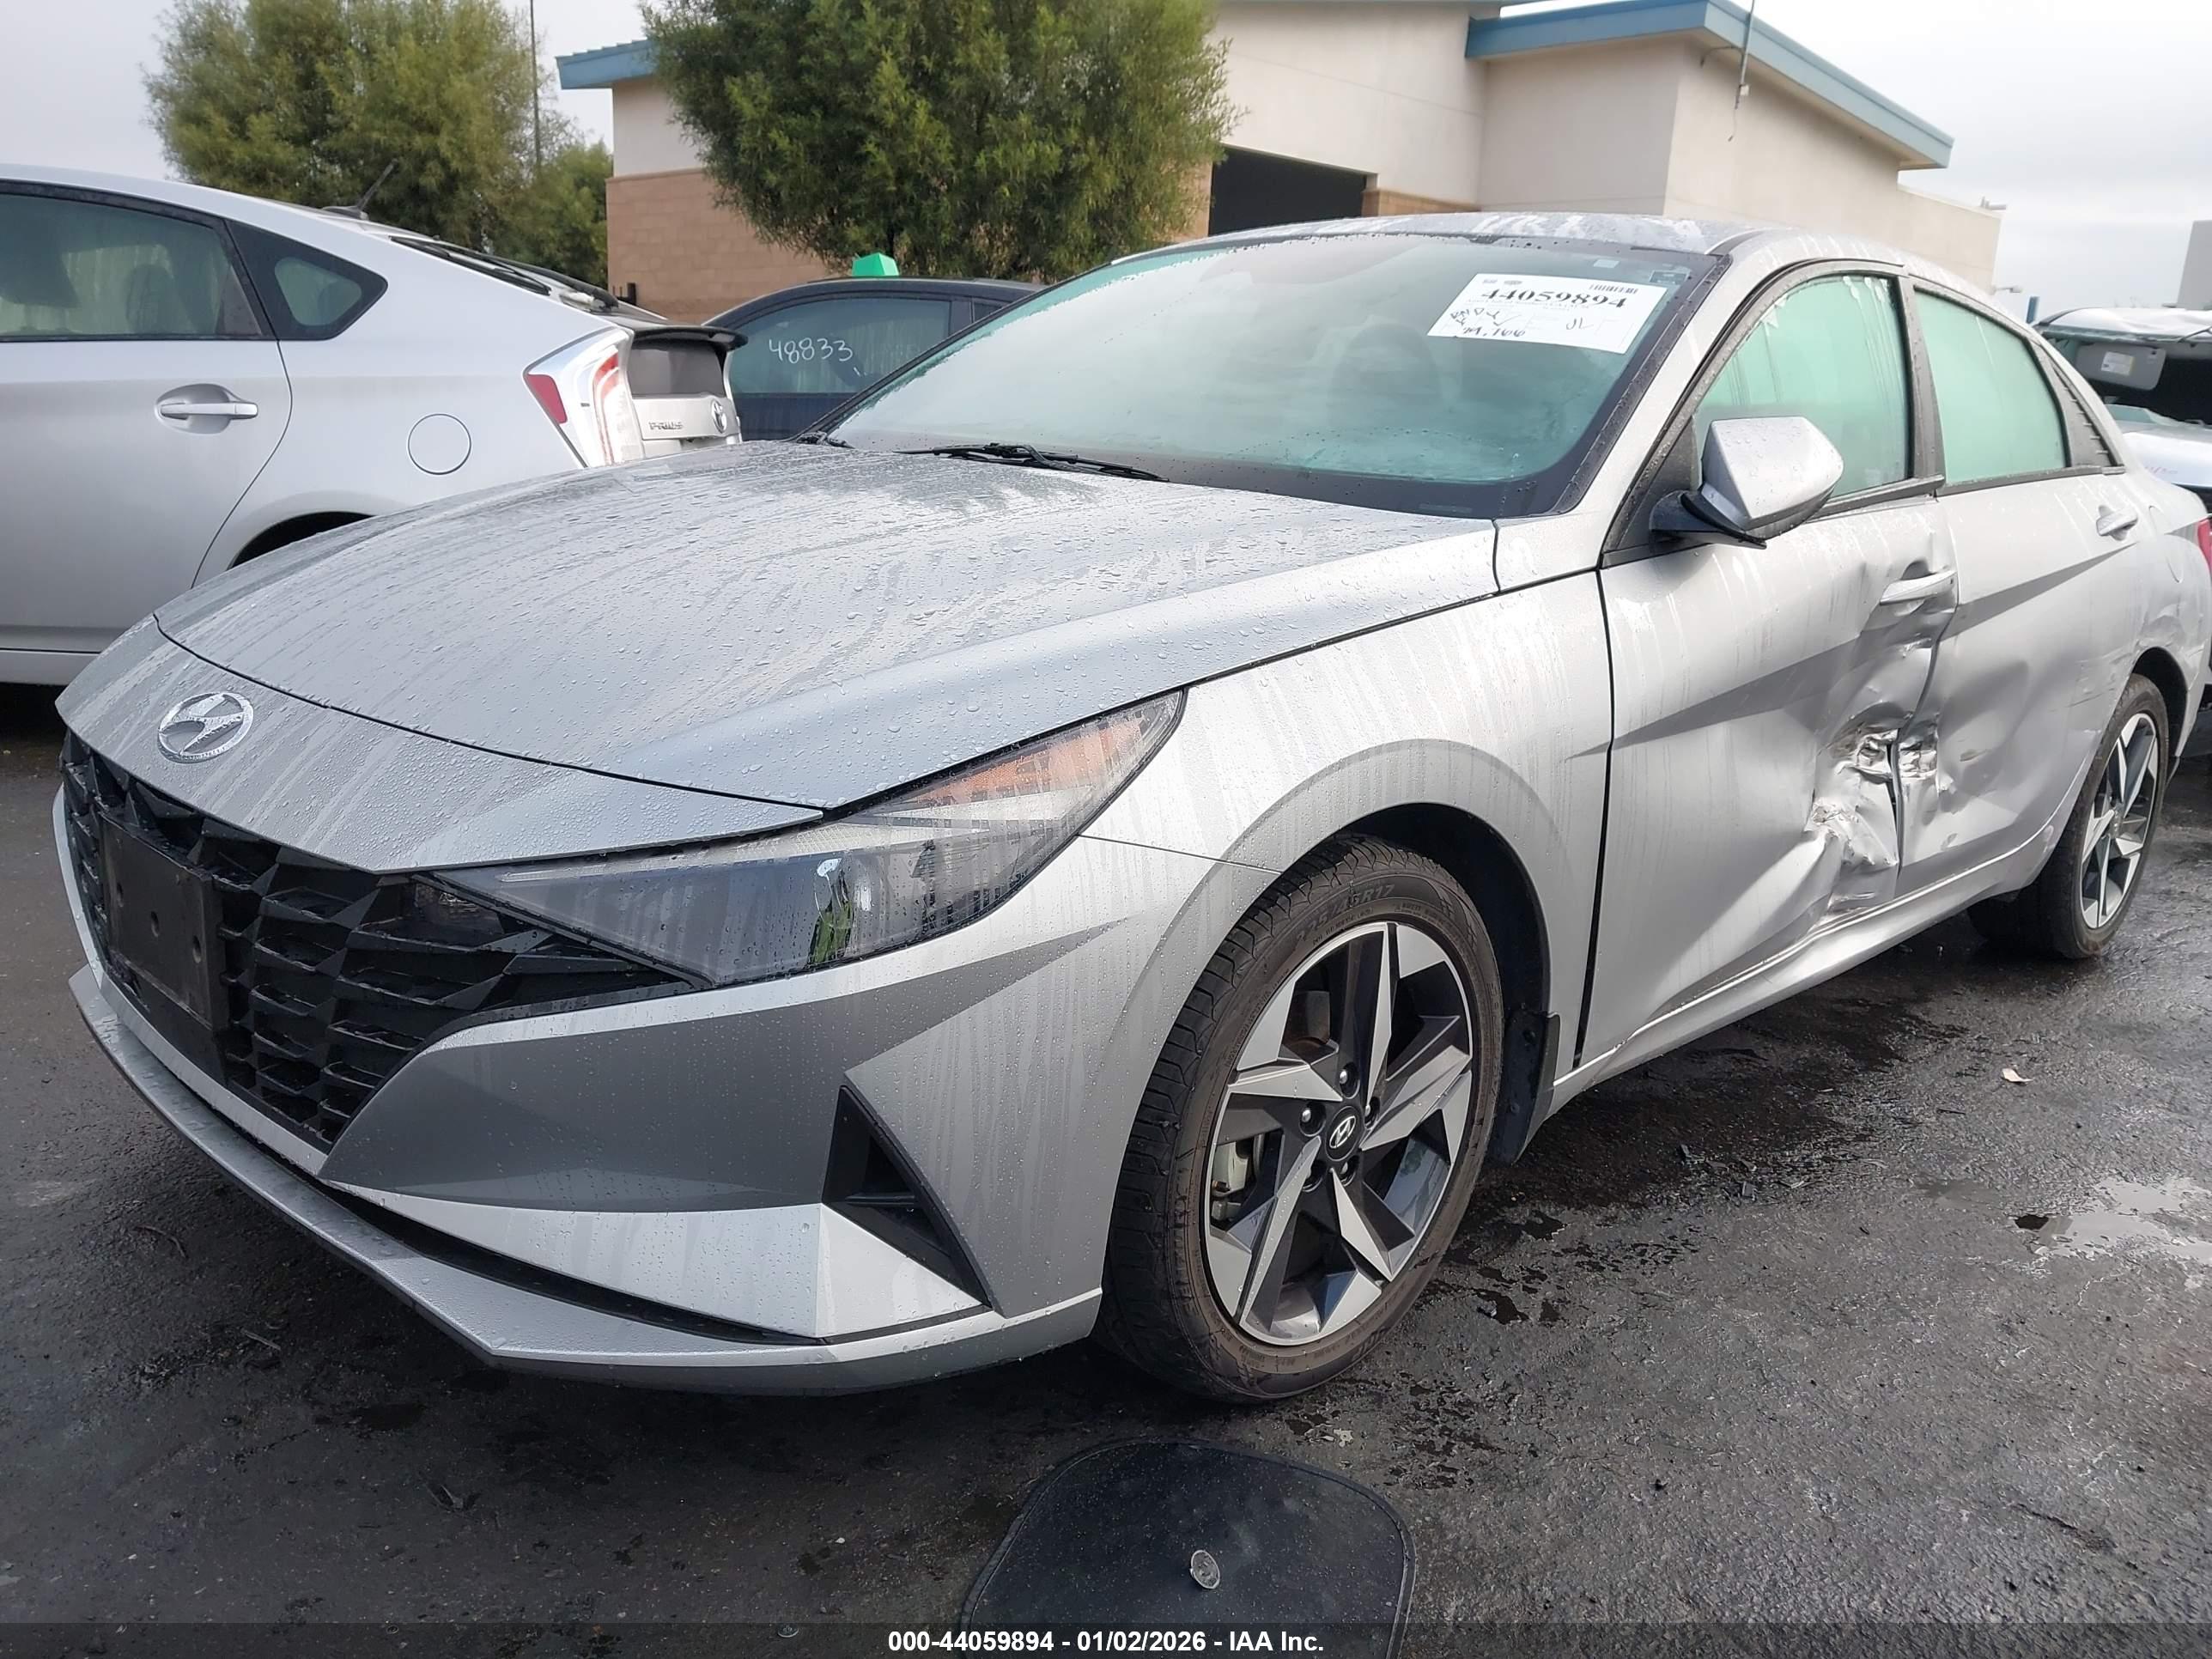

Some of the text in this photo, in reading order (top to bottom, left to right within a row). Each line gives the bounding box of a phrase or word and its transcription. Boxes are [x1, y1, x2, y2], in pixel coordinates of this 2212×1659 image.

[1481, 289, 1627, 307] 44059894
[769, 337, 854, 364] 48833
[648, 421, 684, 430] PRIUS
